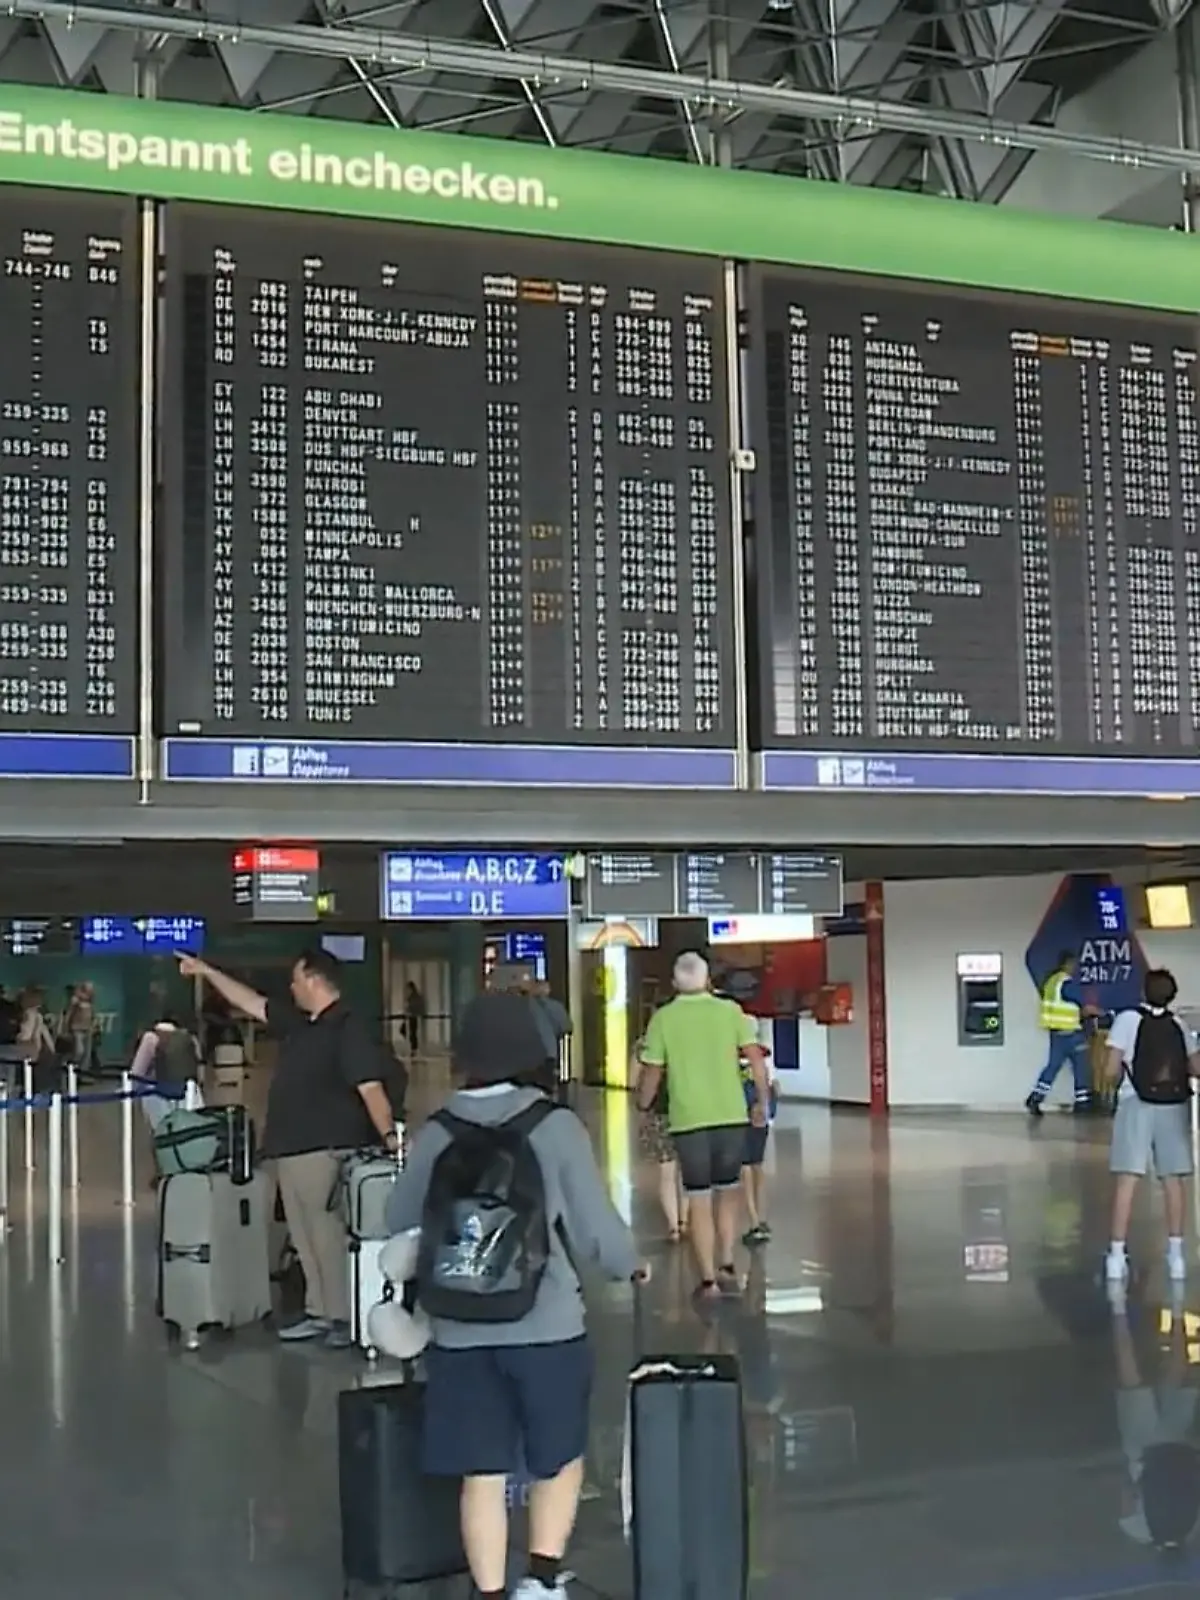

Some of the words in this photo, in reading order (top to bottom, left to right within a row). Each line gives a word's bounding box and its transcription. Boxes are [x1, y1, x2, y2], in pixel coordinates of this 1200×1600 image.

[0, 110, 252, 175] Entspannt
[268, 143, 559, 209] einchecken.
[215, 314, 232, 326] LH
[305, 320, 339, 336] PORT
[215, 332, 232, 344] LH
[305, 338, 356, 355] TIRANA
[305, 356, 374, 374] BUKAREST
[261, 387, 286, 401] 122
[305, 390, 330, 403] ABU
[215, 402, 232, 414] UA
[305, 406, 356, 423] DENVER
[215, 418, 232, 432] LH
[215, 436, 232, 448] LH
[305, 458, 365, 475] FUNCHAL
[215, 472, 232, 484] LH
[215, 490, 232, 502] LH
[215, 506, 232, 520] TK
[215, 596, 232, 610] LH
[215, 614, 232, 628] AZ
[306, 635, 357, 650] BOSTON
[306, 652, 331, 667] SAN
[215, 668, 232, 682] LH
[466, 857, 537, 884] A,B,C,Z
[471, 891, 504, 915] D,E
[1079, 940, 1131, 963] ATM
